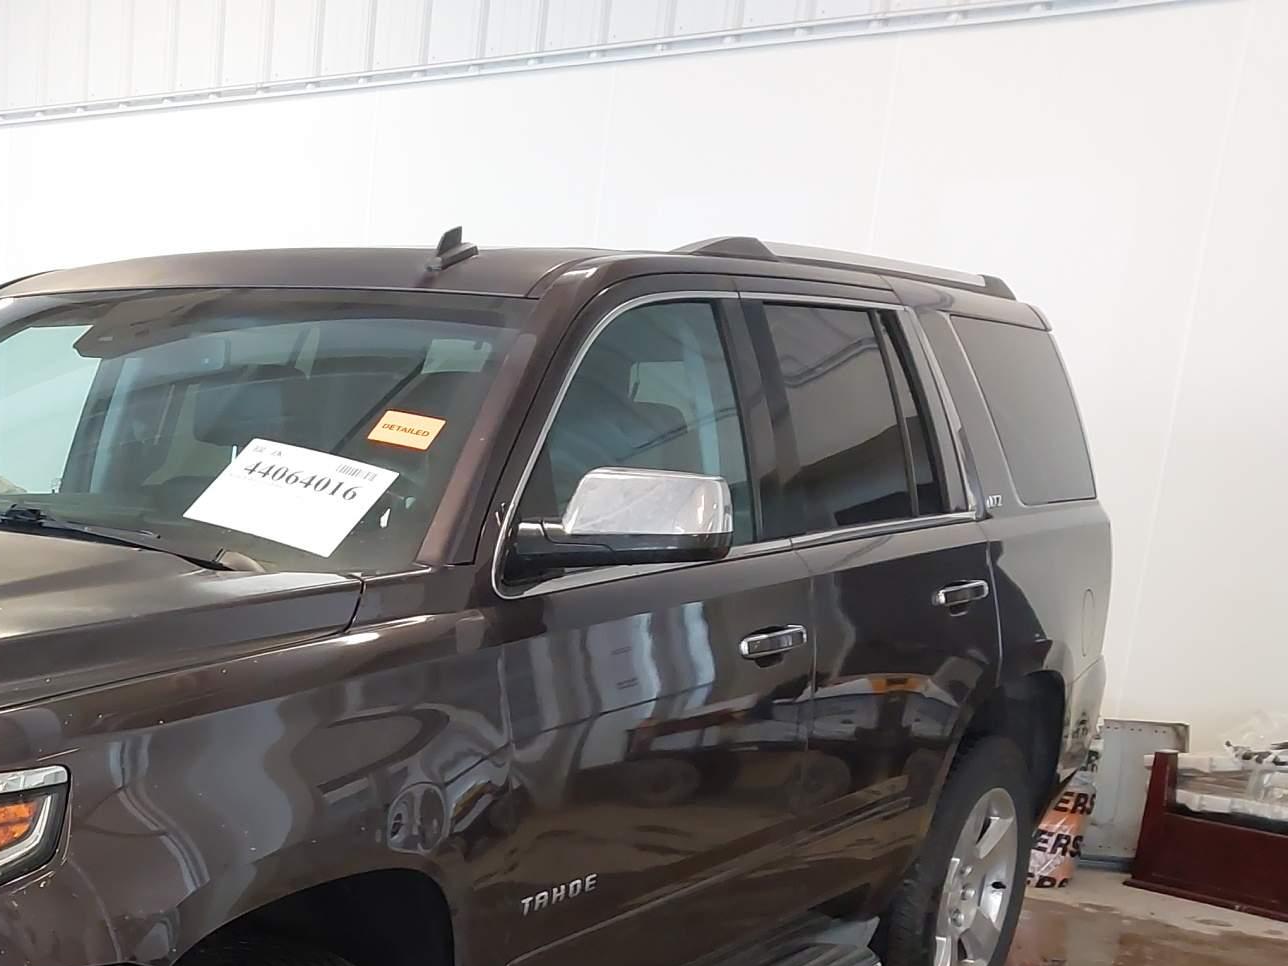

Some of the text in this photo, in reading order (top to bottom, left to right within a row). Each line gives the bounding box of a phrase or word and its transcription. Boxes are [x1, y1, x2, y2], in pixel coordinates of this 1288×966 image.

[381, 423, 430, 437] DETAILED
[244, 460, 363, 501] 44064016
[520, 873, 598, 917] TAHOE
